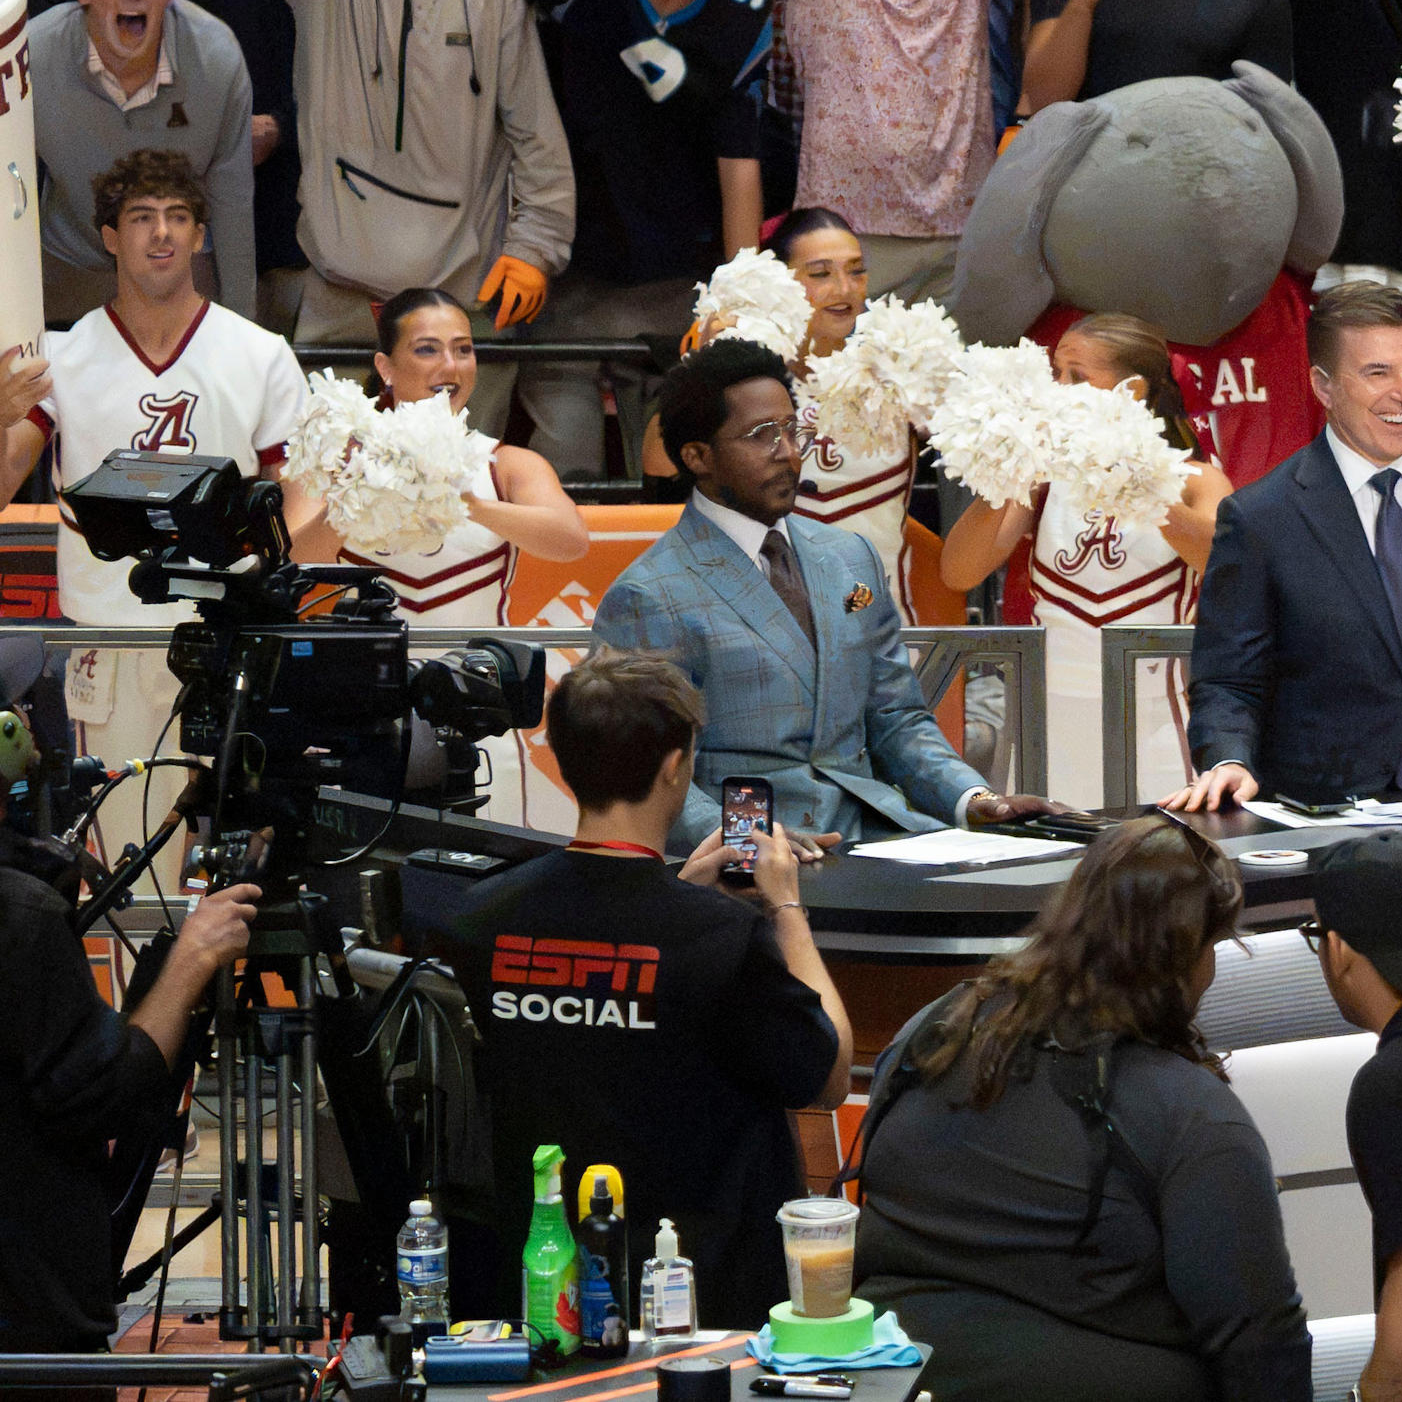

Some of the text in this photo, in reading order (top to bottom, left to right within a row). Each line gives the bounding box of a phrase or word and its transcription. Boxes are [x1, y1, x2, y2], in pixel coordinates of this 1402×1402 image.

[1211, 357, 1268, 406] AL
[490, 934, 661, 994] ESPN
[491, 991, 657, 1030] SOCIAL
